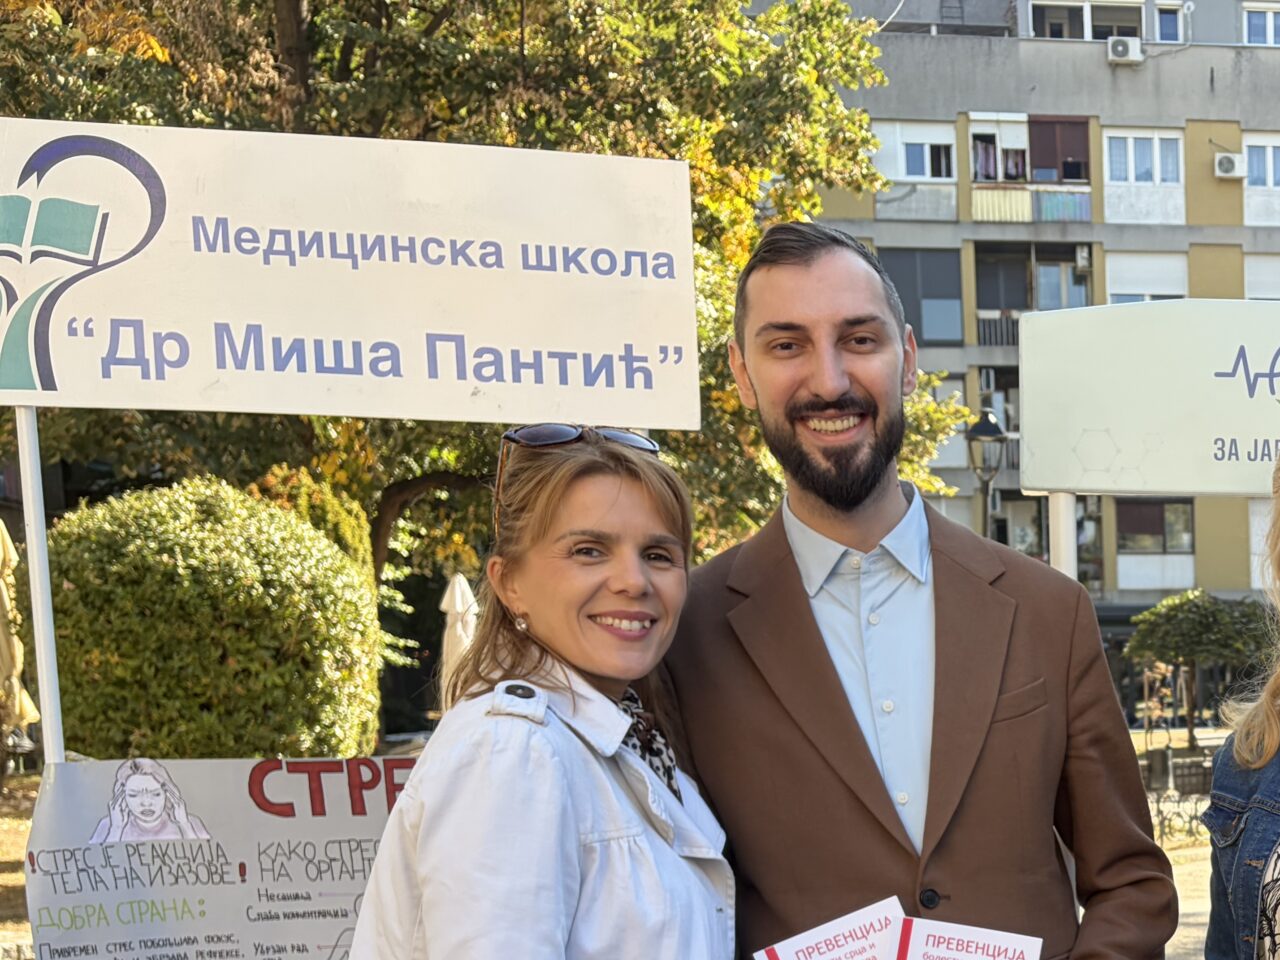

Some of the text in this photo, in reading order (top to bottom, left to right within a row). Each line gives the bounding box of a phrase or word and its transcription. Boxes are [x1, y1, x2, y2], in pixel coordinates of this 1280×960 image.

[191, 215, 676, 280] Медицинска школа
[214, 322, 404, 378] Миша
[1213, 437, 1240, 461] ЗА
[100, 842, 120, 869] ЈЕ
[125, 839, 231, 867] РЕАКЦИЈА
[258, 839, 316, 862] КАКО
[43, 867, 110, 895] ТЕЛА
[112, 866, 146, 890] НА
[258, 860, 293, 882] НА
[36, 902, 110, 933] ДОБРА
[105, 940, 135, 954] СТРЕС
[138, 936, 199, 951] ПОБОЉШАВА
[868, 943, 877, 951] и
